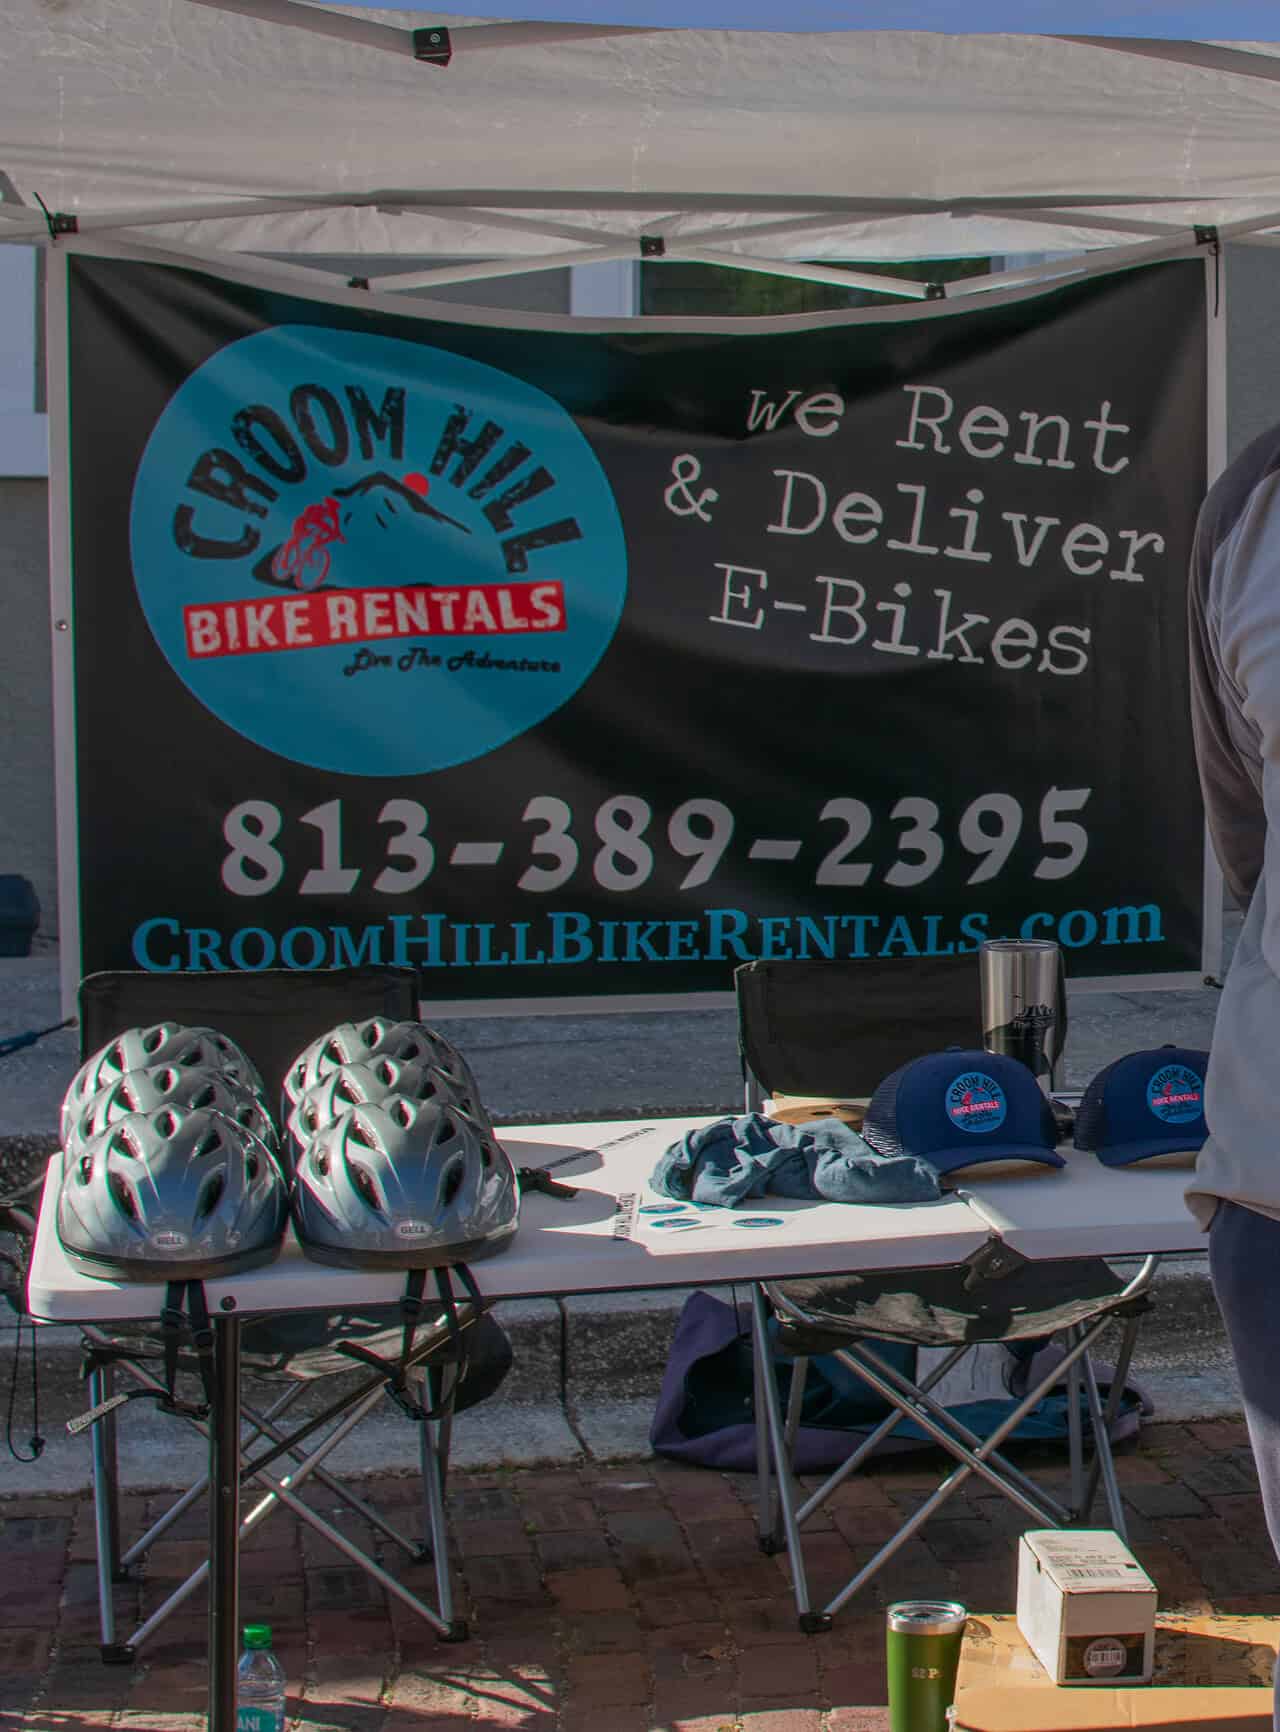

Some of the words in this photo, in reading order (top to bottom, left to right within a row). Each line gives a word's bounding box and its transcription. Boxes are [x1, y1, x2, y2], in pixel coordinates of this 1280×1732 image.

[173, 382, 407, 560] CROOM
[428, 402, 584, 574] HILL
[895, 384, 1130, 475] Rent
[664, 453, 719, 523] &
[766, 469, 1165, 582] Deliver
[187, 599, 316, 656] BIKE
[327, 585, 563, 641] RENTALS
[397, 648, 443, 672] The
[447, 650, 562, 673] Adventure
[708, 562, 1092, 675] E-Bikes
[221, 785, 1093, 896] 813-389-2395
